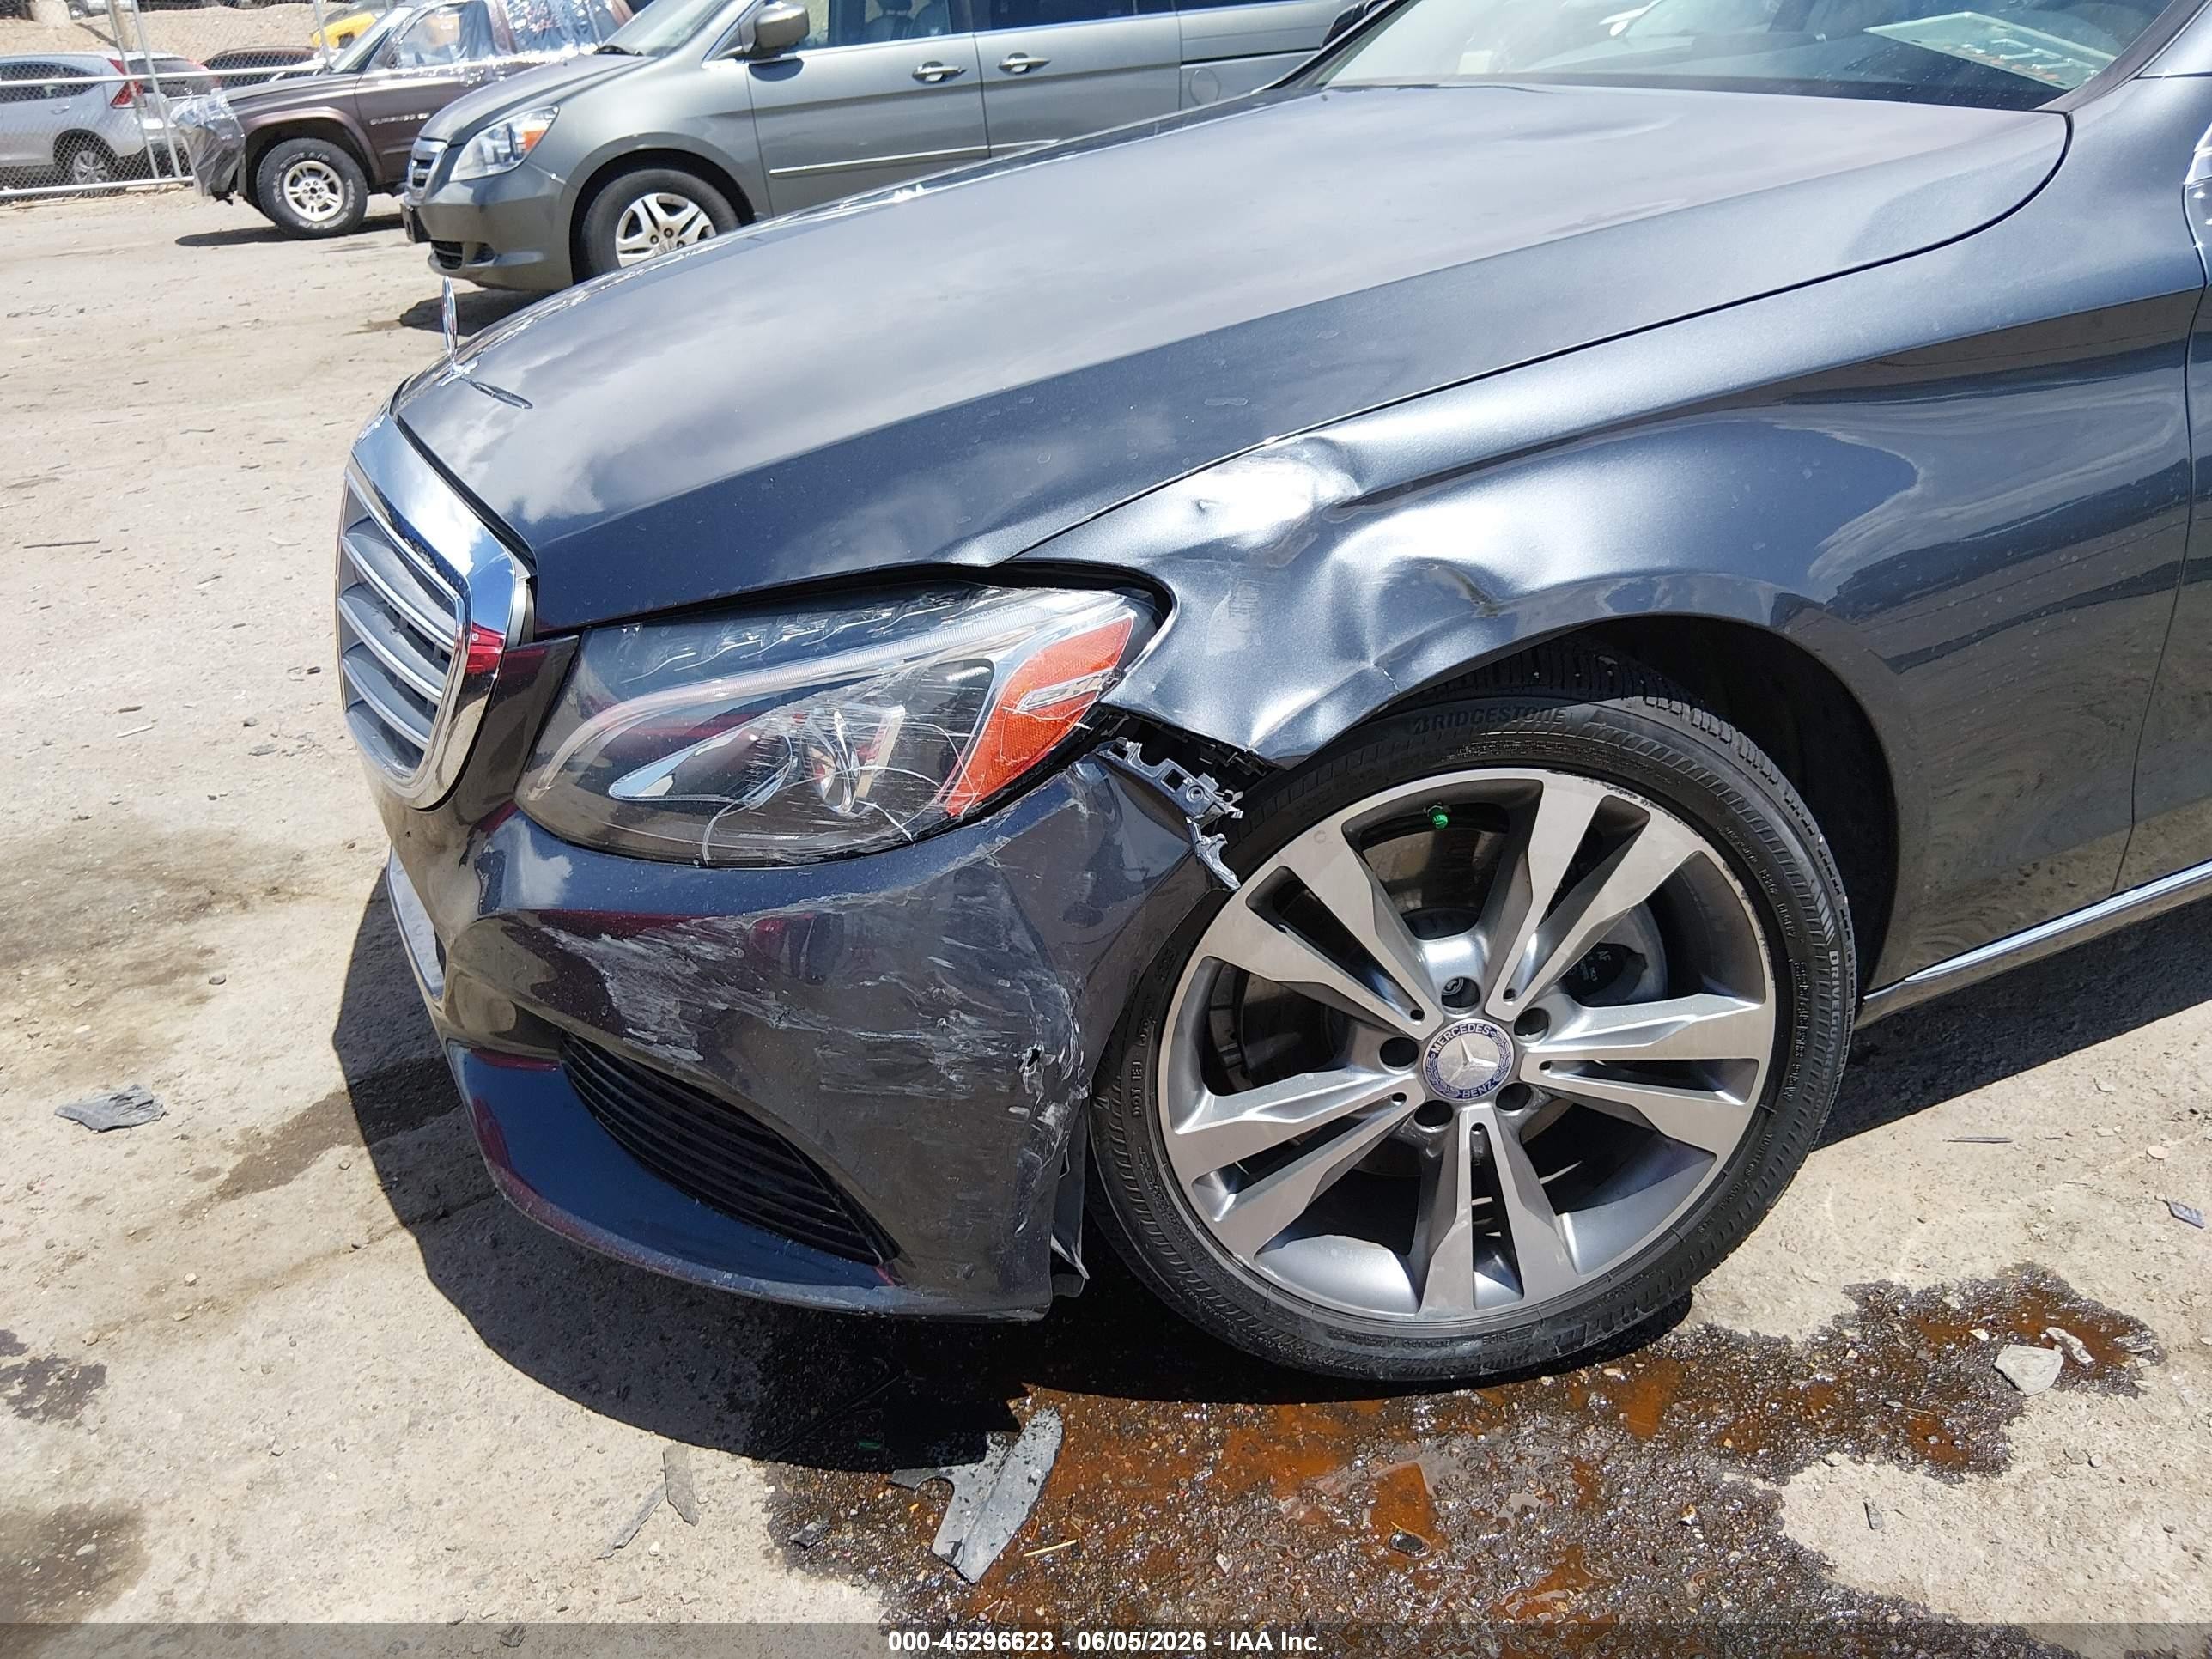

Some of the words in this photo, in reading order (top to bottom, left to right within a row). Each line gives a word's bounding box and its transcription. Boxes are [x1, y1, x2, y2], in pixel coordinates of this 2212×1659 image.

[1413, 706, 1568, 734] BRIDGESTONE
[1431, 1024, 1492, 1054] MERCEDES
[1462, 1082, 1494, 1098] BENZ
